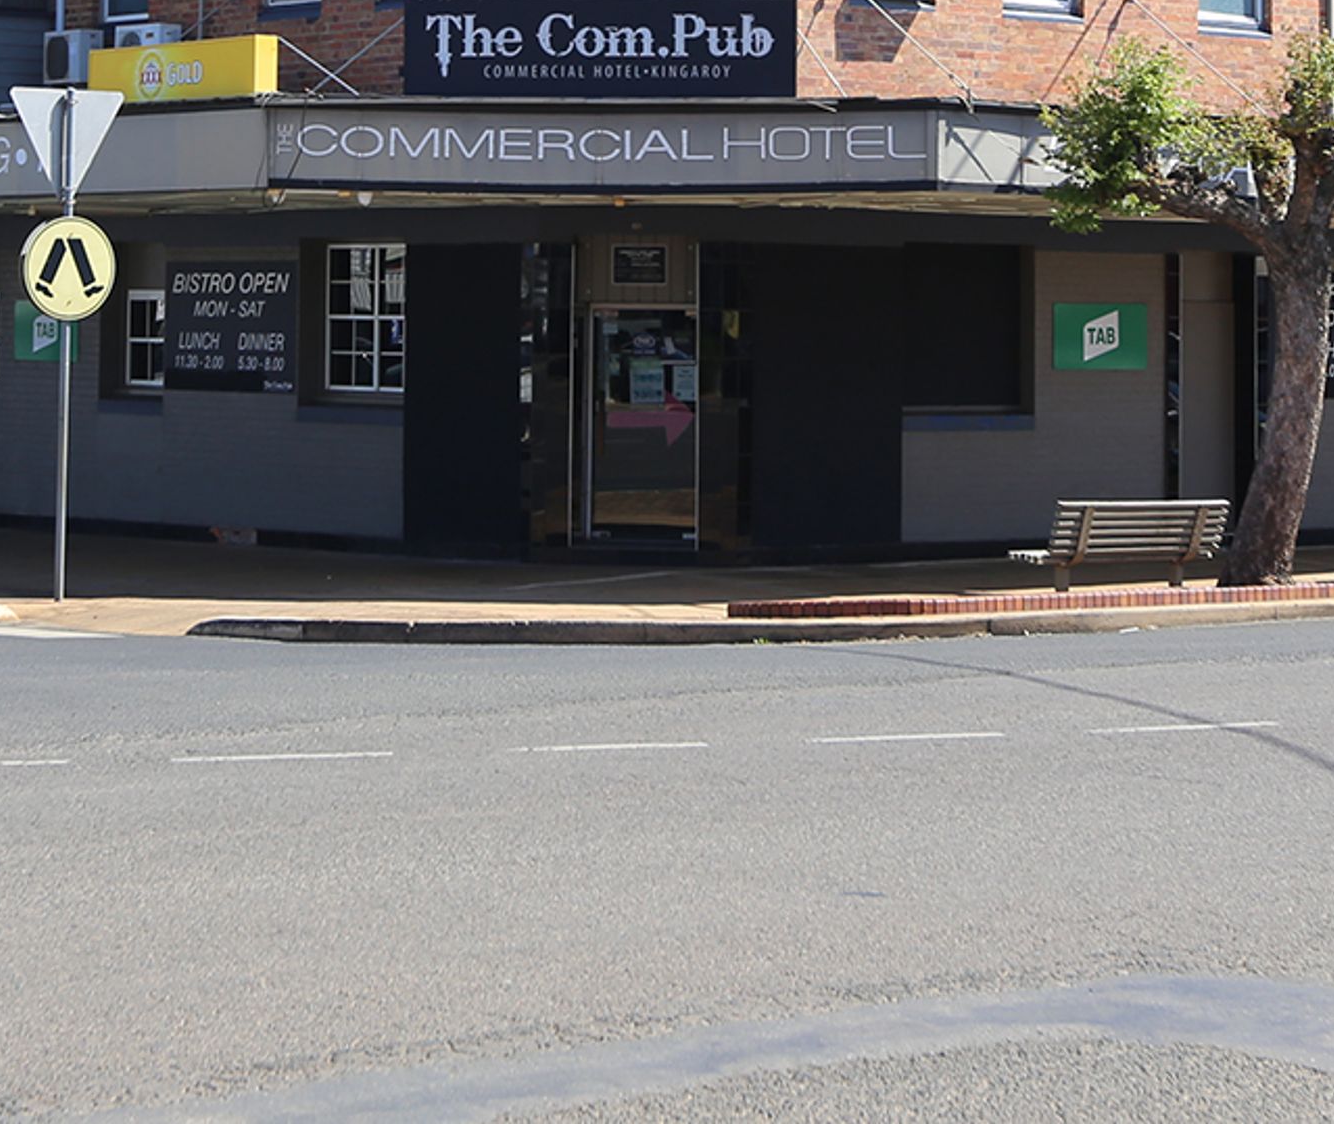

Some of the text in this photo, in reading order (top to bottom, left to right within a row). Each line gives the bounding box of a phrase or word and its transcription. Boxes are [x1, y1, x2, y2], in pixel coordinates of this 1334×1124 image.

[426, 13, 776, 77] The Com.Pub
[167, 60, 204, 86] GOLD
[483, 64, 585, 79] COMMERCIAL
[276, 124, 927, 160] THE COMMERCIAL HOTEL
[172, 272, 290, 294] BISTRO OPEN
[194, 300, 228, 317] MON
[238, 300, 266, 317] SAT
[36, 322, 55, 338] TAB
[1087, 326, 1116, 345] TAB
[179, 332, 221, 350] LUNCH
[237, 332, 285, 351] DINNER
